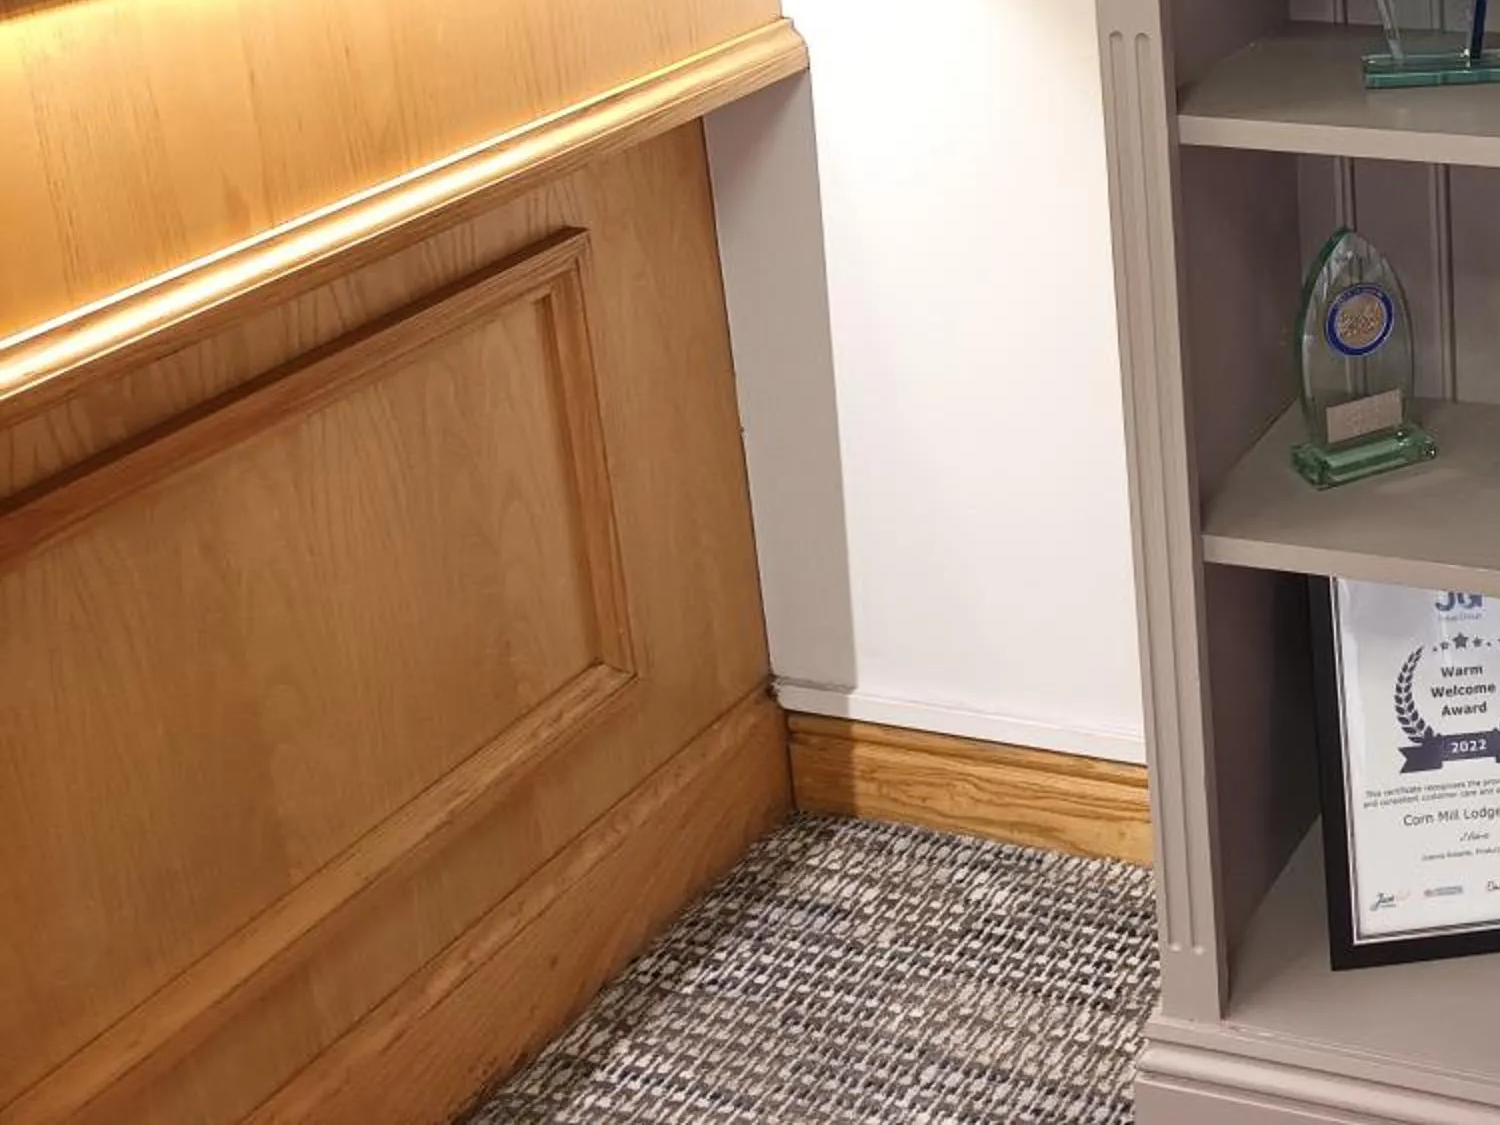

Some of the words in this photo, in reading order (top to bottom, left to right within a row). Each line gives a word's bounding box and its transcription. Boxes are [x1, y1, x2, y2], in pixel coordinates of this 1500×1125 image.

[1440, 664, 1483, 678] Warm
[1430, 683, 1497, 698] Welcome
[1441, 701, 1488, 717] Award
[1450, 739, 1487, 754] 2022
[1467, 779, 1481, 788] the
[1421, 791, 1458, 802] customer
[1461, 789, 1478, 798] care
[1479, 787, 1494, 797] and
[1403, 813, 1434, 827] Corn
[1438, 809, 1460, 822] Mill
